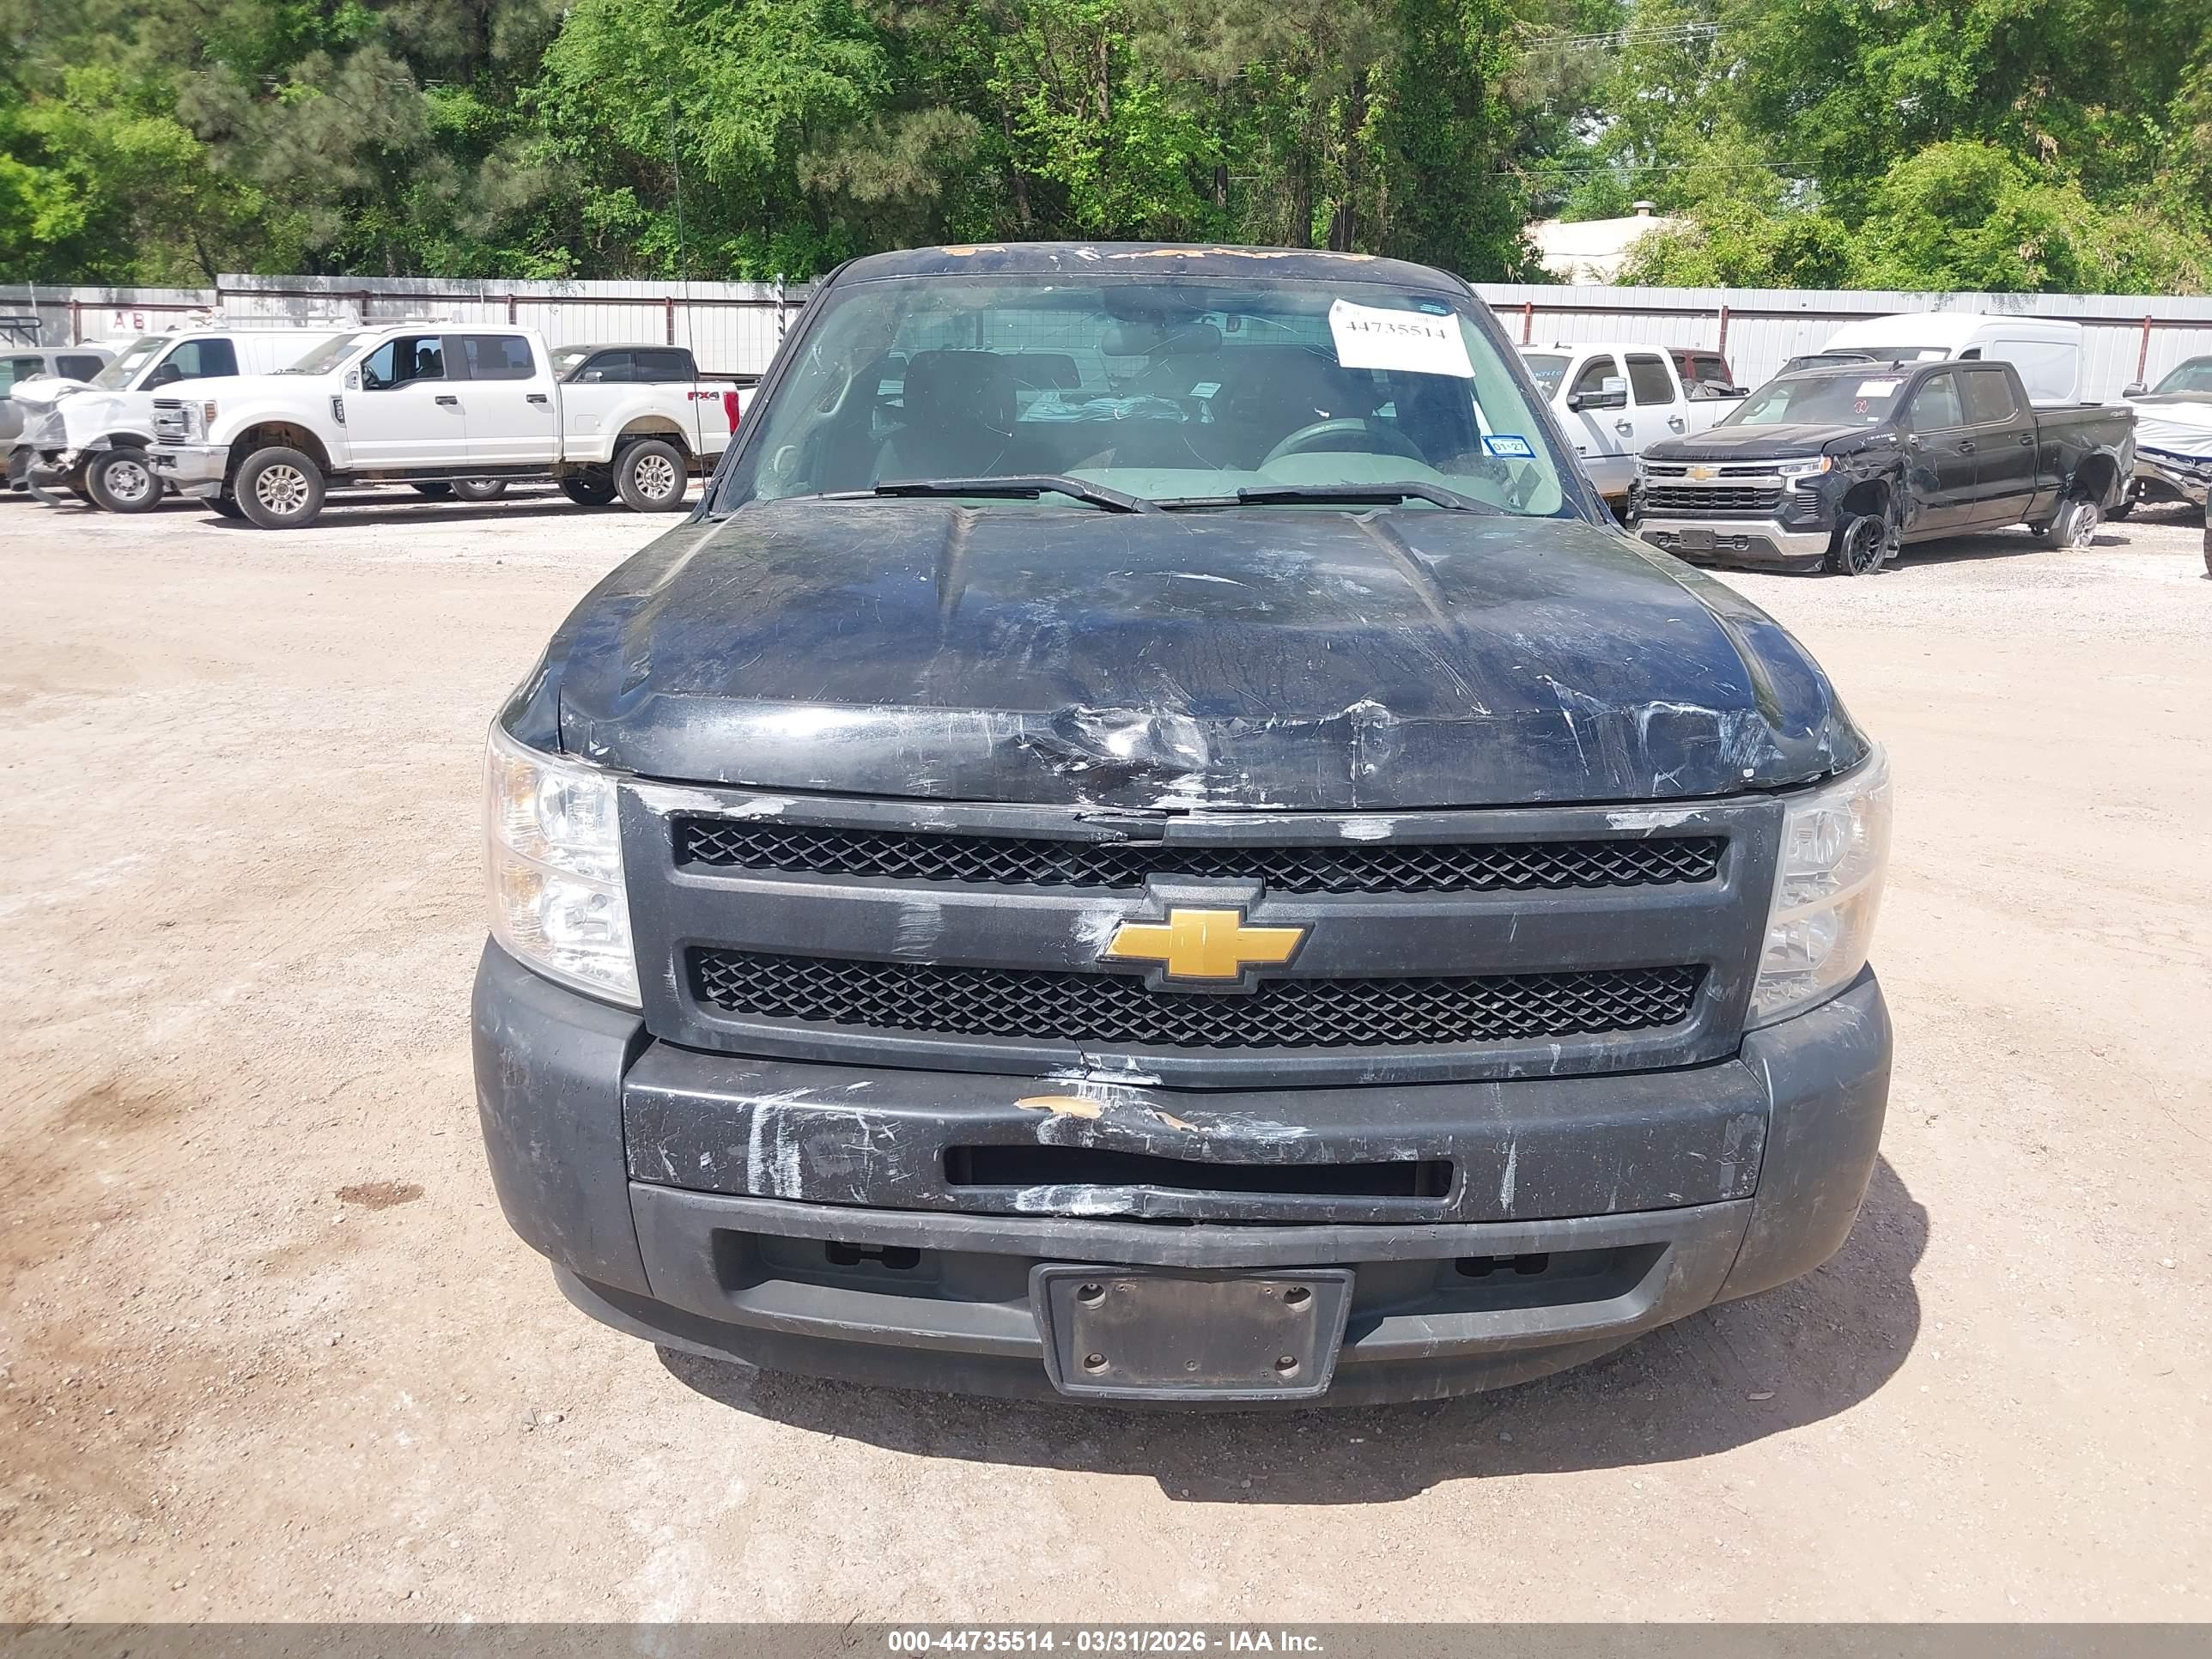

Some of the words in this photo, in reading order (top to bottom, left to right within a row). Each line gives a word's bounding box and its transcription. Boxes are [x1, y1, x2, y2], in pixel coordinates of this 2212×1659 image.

[1346, 321, 1447, 340] 44735514
[687, 392, 720, 401] FX4
[1492, 442, 1524, 451] 01-27
